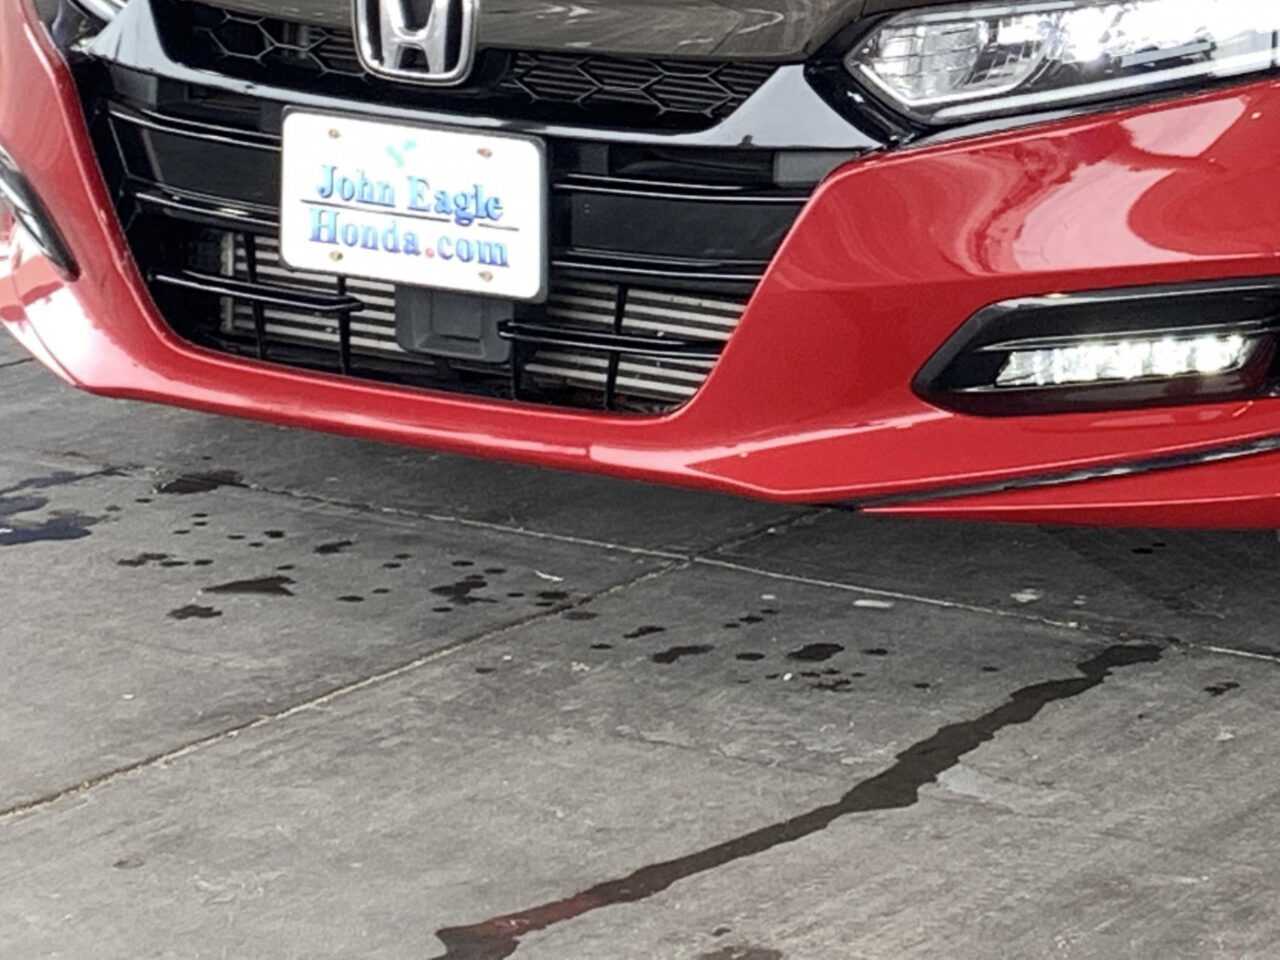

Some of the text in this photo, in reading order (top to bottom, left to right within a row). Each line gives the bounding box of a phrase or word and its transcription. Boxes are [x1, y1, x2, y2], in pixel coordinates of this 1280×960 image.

[317, 164, 504, 226] John Eagle
[309, 208, 510, 268] Honda.com
